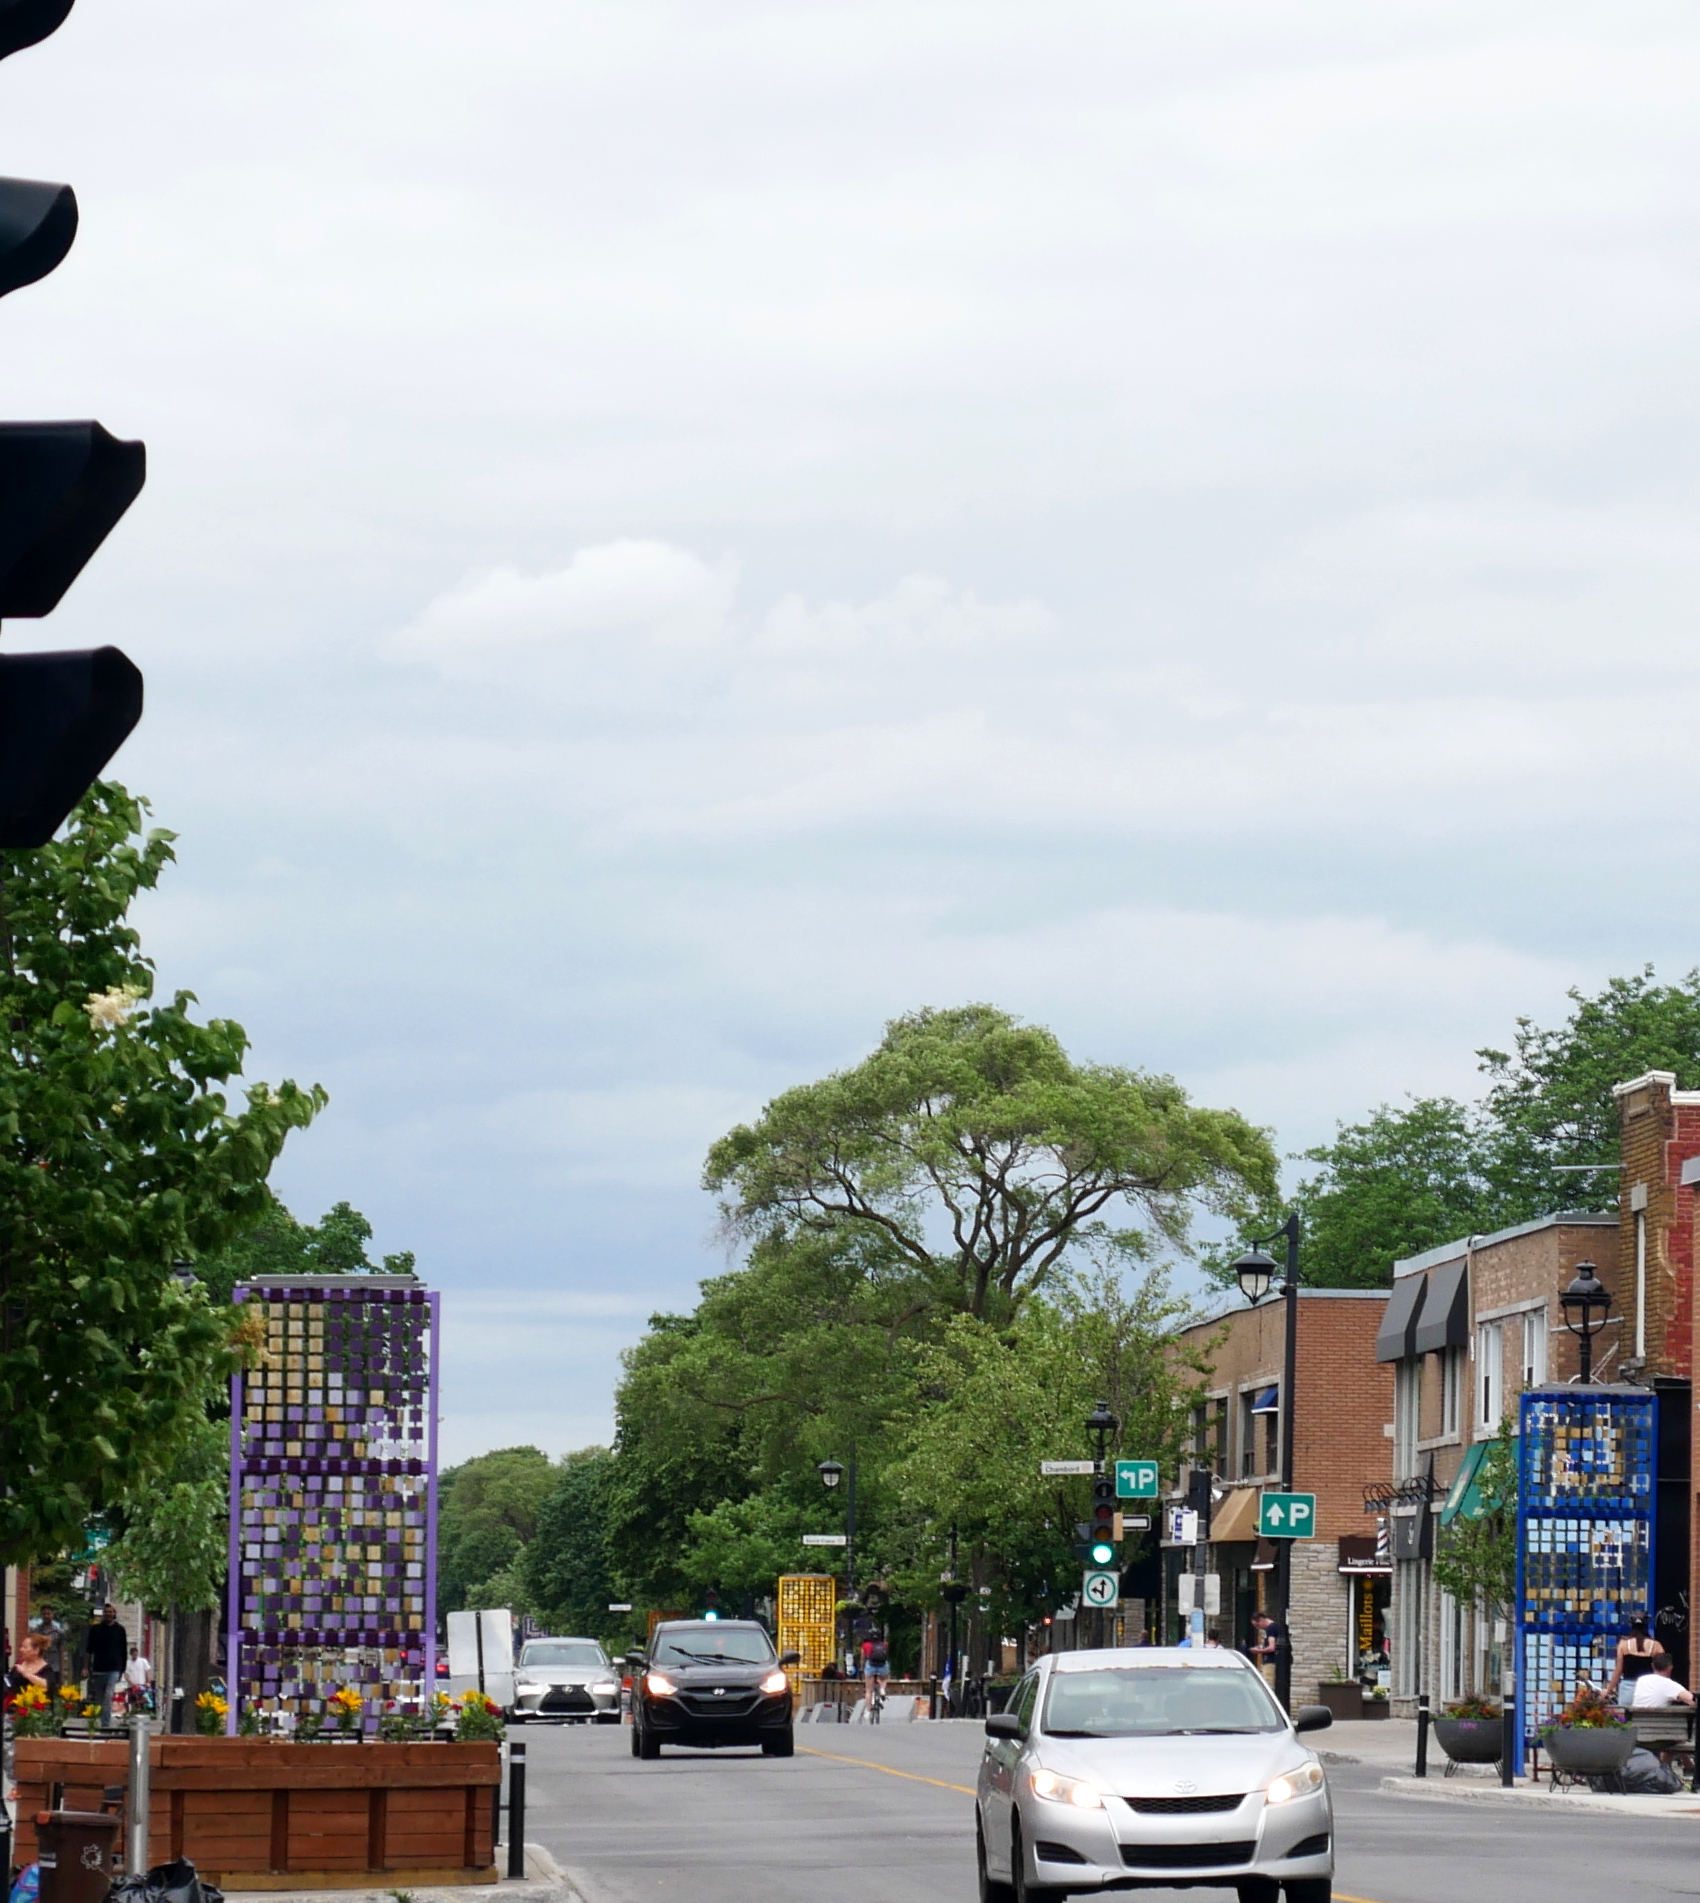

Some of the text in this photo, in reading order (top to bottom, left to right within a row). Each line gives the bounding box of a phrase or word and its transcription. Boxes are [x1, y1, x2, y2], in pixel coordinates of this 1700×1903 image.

[1045, 1465, 1080, 1473] Chambord
[1139, 1468, 1155, 1490] P
[1289, 1502, 1311, 1528] P
[1358, 1592, 1374, 1651] Maillots
